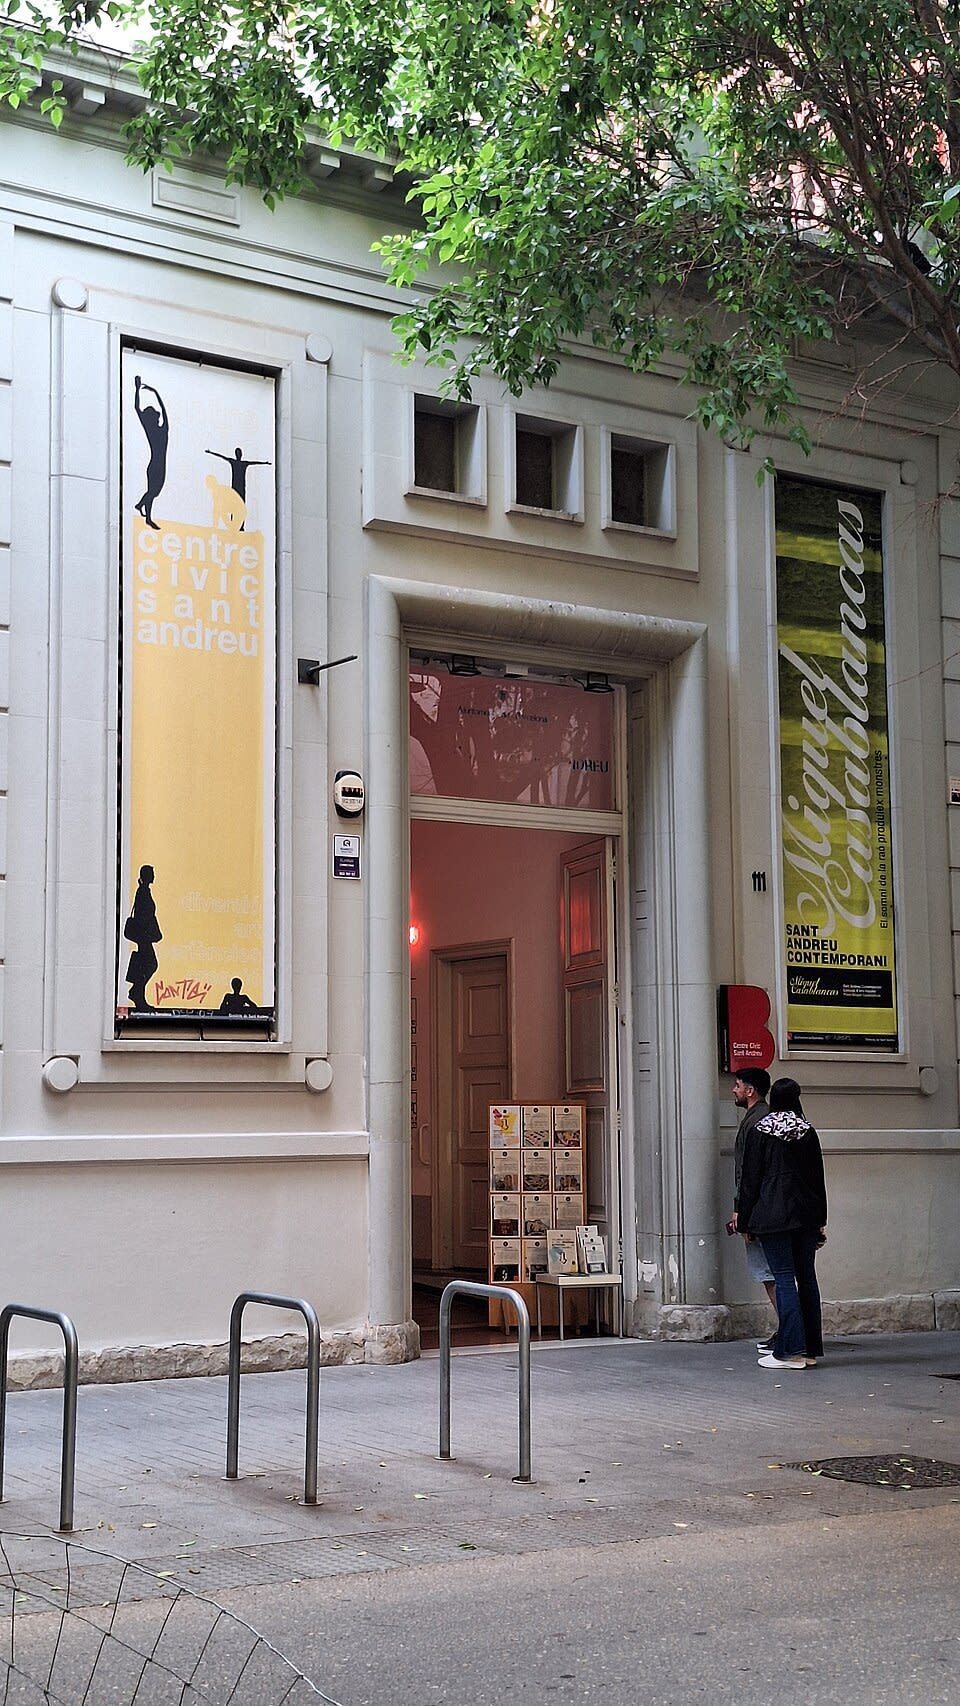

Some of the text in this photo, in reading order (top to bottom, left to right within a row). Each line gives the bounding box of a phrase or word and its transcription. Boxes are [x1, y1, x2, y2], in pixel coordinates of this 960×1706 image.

[137, 530, 259, 569] centre
[137, 589, 258, 628] sant
[137, 619, 258, 657] andreu
[873, 750, 884, 797] monstres
[878, 889, 888, 918] somni
[786, 924, 819, 937] SANT
[787, 938, 838, 952] ANDREU
[787, 951, 888, 968] CONTEMPORANI
